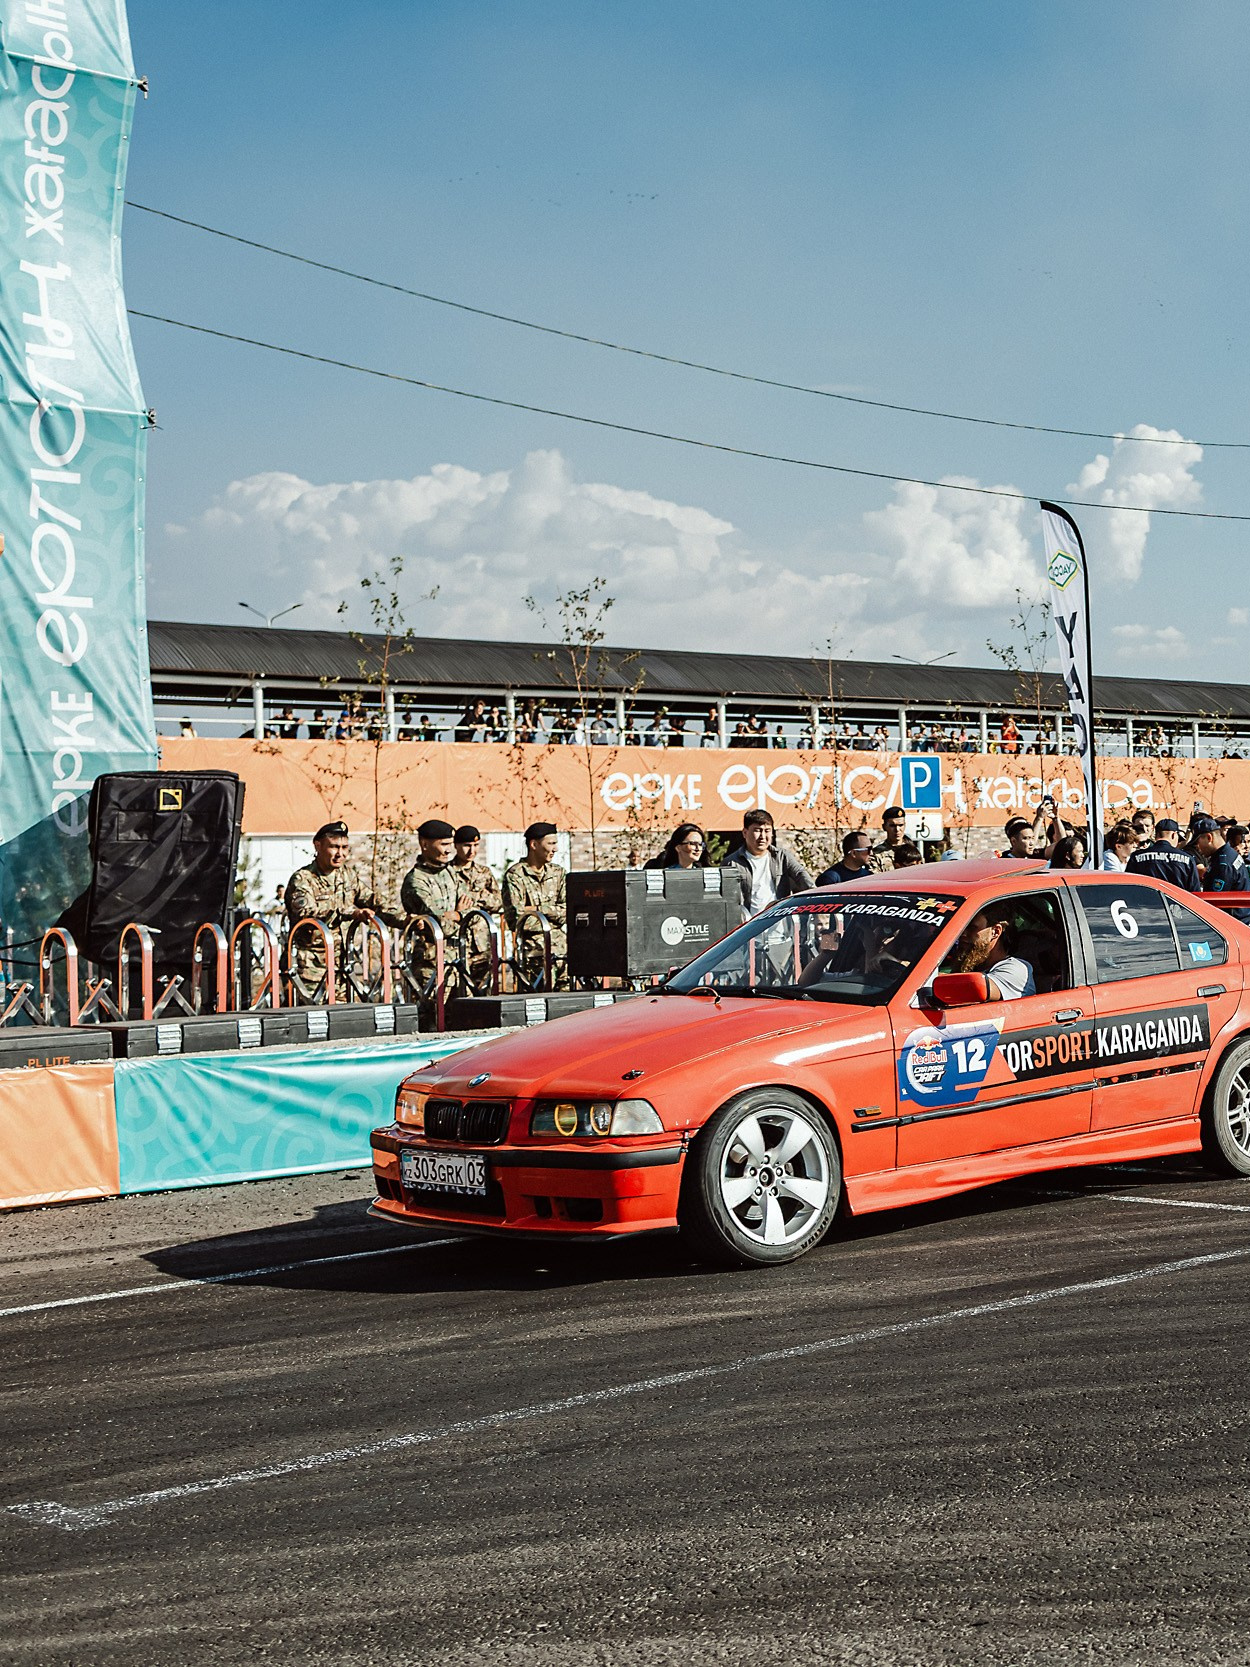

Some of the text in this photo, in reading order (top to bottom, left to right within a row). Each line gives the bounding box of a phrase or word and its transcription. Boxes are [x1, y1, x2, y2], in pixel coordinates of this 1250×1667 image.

[909, 762, 932, 804] P
[839, 903, 945, 927] KARAGANDA
[1110, 900, 1139, 939] 6
[1097, 1015, 1204, 1058] KARAGANDA
[28, 1059, 43, 1068] PL
[911, 1050, 947, 1065] Red Bull
[951, 1038, 987, 1073] 12
[914, 1066, 927, 1074] CAR
[467, 1161, 485, 1185] 03
